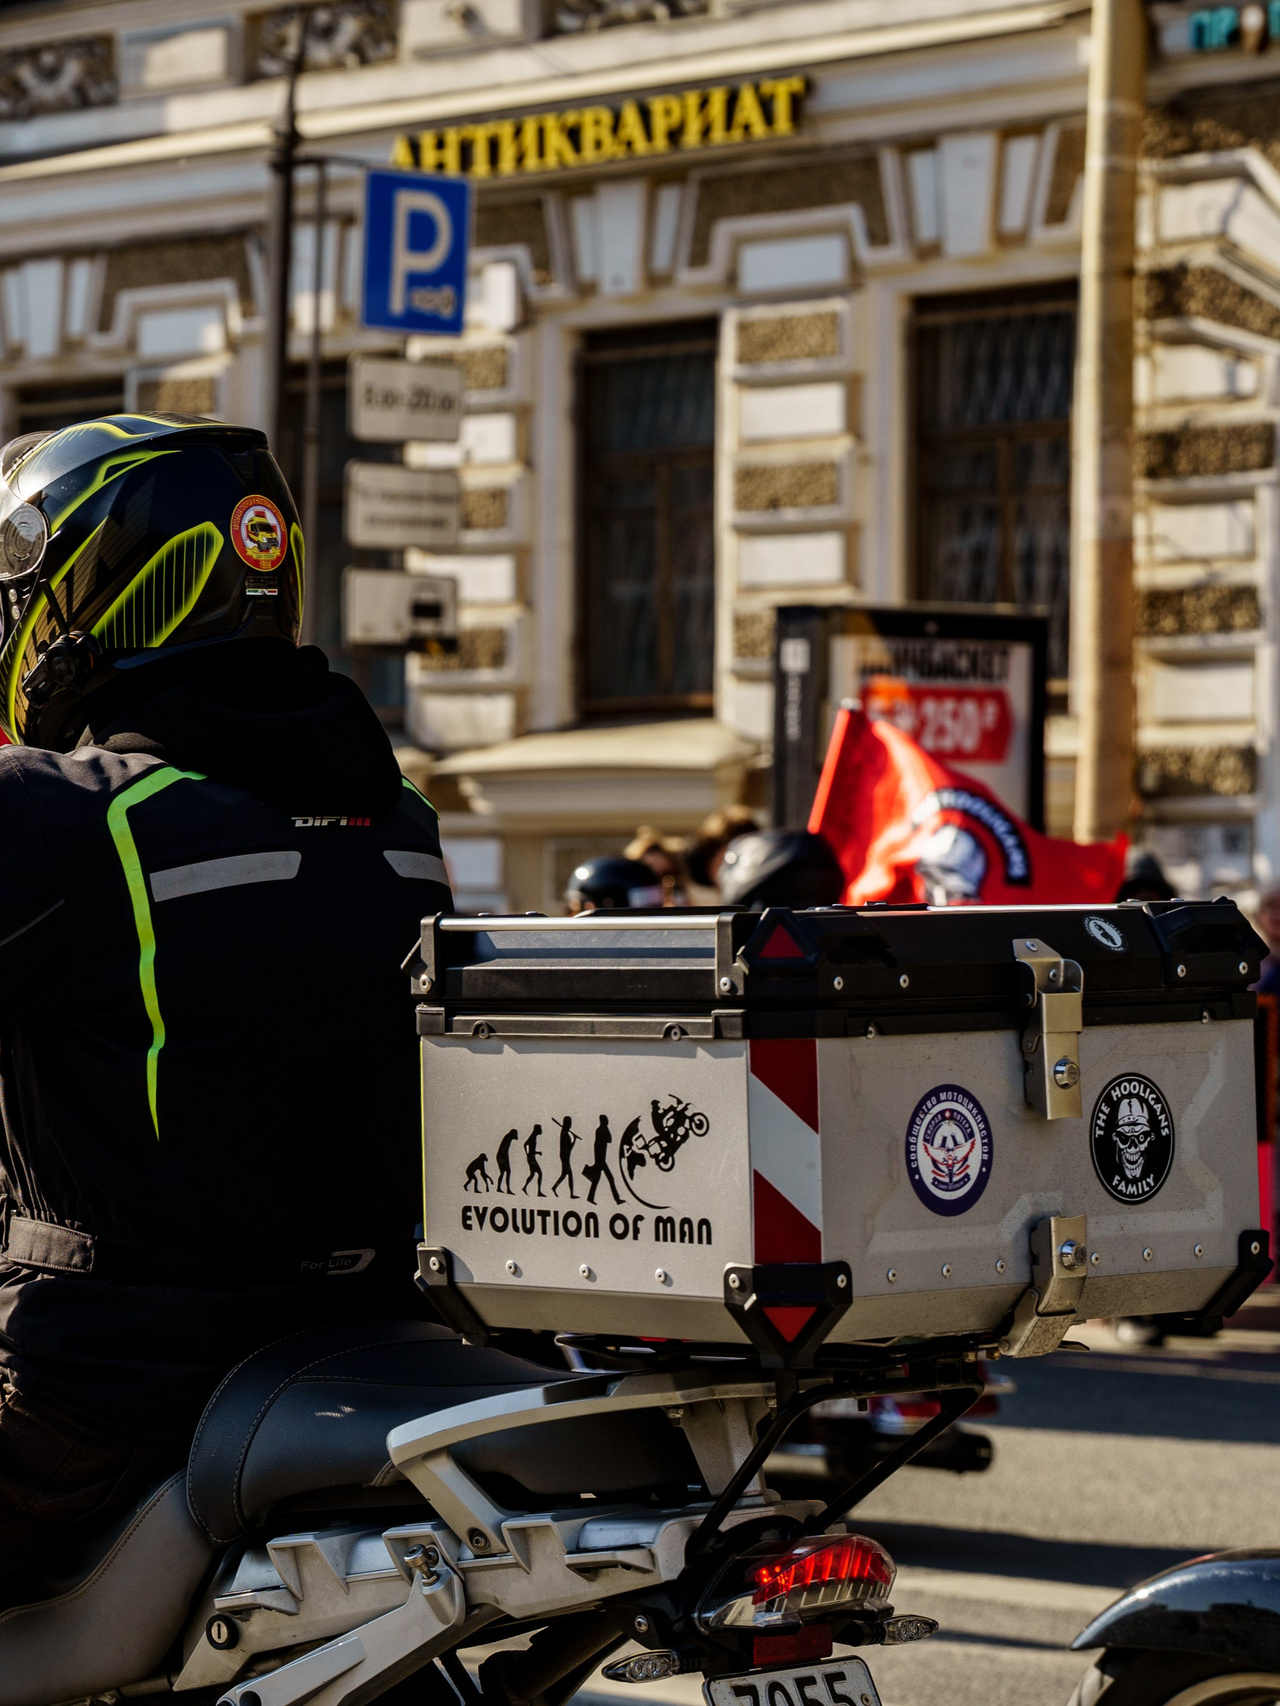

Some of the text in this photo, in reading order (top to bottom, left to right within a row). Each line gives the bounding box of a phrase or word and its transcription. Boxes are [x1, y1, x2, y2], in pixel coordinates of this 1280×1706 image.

[389, 74, 809, 180] АНТИКВАРИАТ
[389, 187, 454, 318] P
[1095, 1081, 1170, 1138] THE HOOLIGANS
[1112, 1173, 1156, 1196] FAMILY
[461, 1204, 713, 1246] EVOLUTION OF MAN
[300, 1257, 352, 1270] For Life
